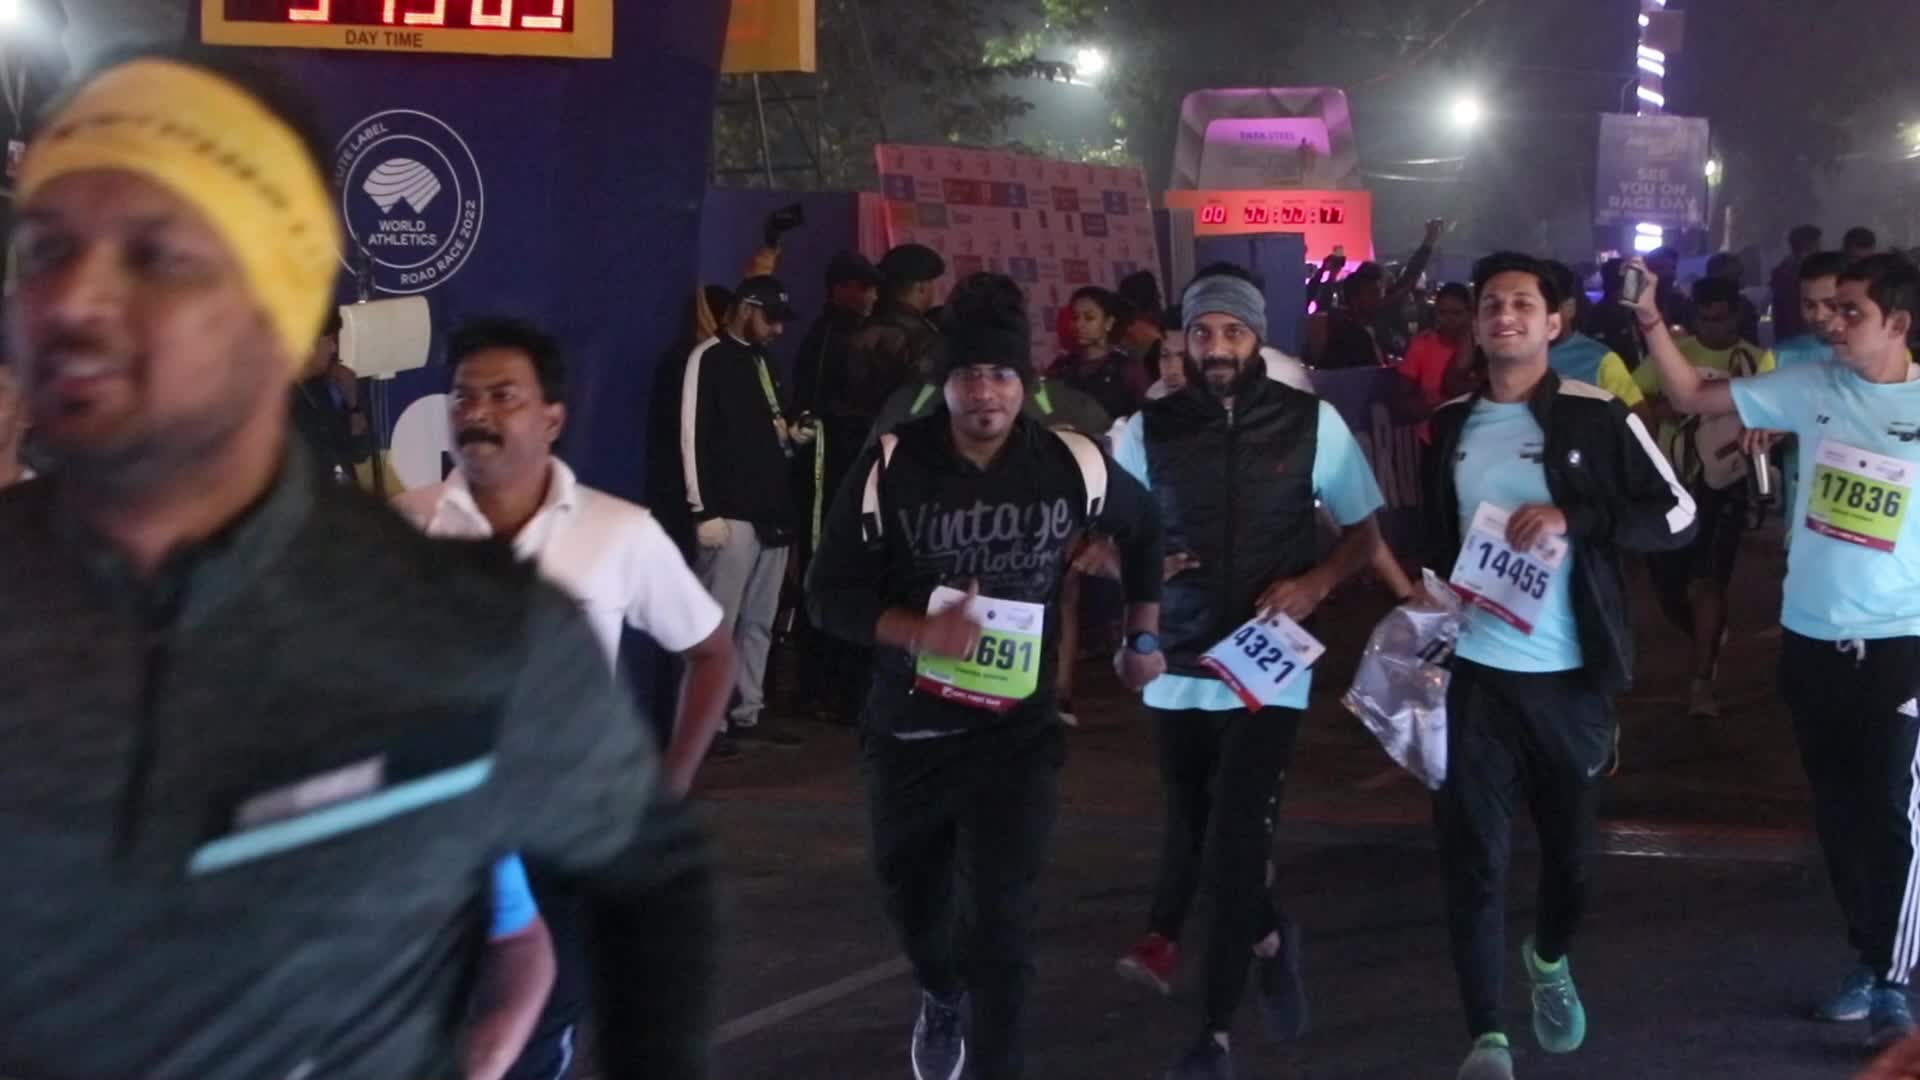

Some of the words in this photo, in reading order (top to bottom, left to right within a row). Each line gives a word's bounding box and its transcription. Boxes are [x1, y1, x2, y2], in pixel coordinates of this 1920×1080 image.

[344, 29, 380, 46] DAY
[384, 31, 424, 48] TIME
[349, 121, 390, 151] LABEL
[1608, 195, 1655, 209] RACE
[1660, 196, 1697, 211] DAY
[1618, 182, 1656, 195] YOU
[1660, 183, 1688, 196] ON
[368, 234, 438, 246] ATHLETICS
[378, 220, 427, 232] WORLD
[400, 267, 437, 285] ROAD
[436, 239, 465, 272] RACE
[460, 199, 477, 240] 2022
[1821, 472, 1902, 518] 17836
[897, 497, 1073, 551] Vintage
[1478, 541, 1549, 600] 14455
[964, 635, 1034, 673] 691
[1232, 626, 1297, 685] 4321
